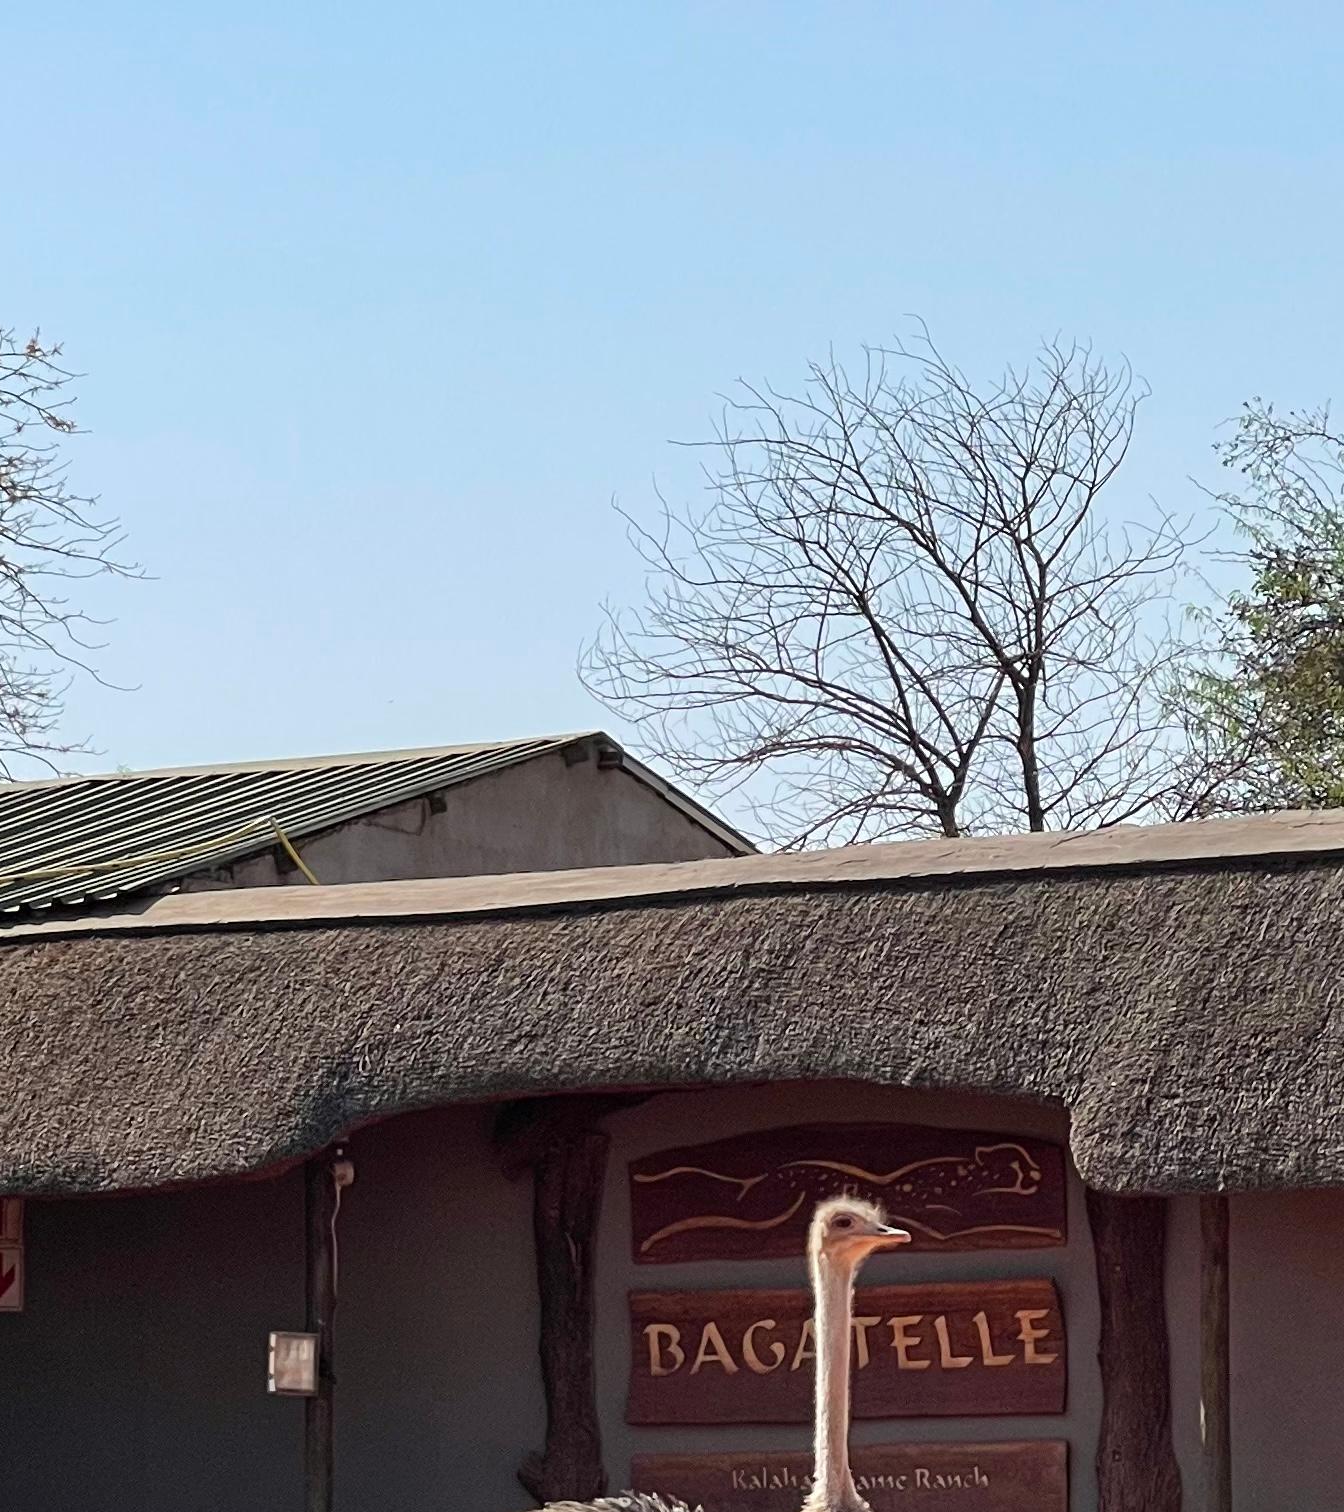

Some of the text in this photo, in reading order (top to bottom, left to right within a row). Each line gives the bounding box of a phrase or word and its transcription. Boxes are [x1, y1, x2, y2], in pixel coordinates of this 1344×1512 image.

[643, 1309, 1058, 1377] BAGATELLE
[732, 1466, 989, 1491] Kalaha ame Ranch
